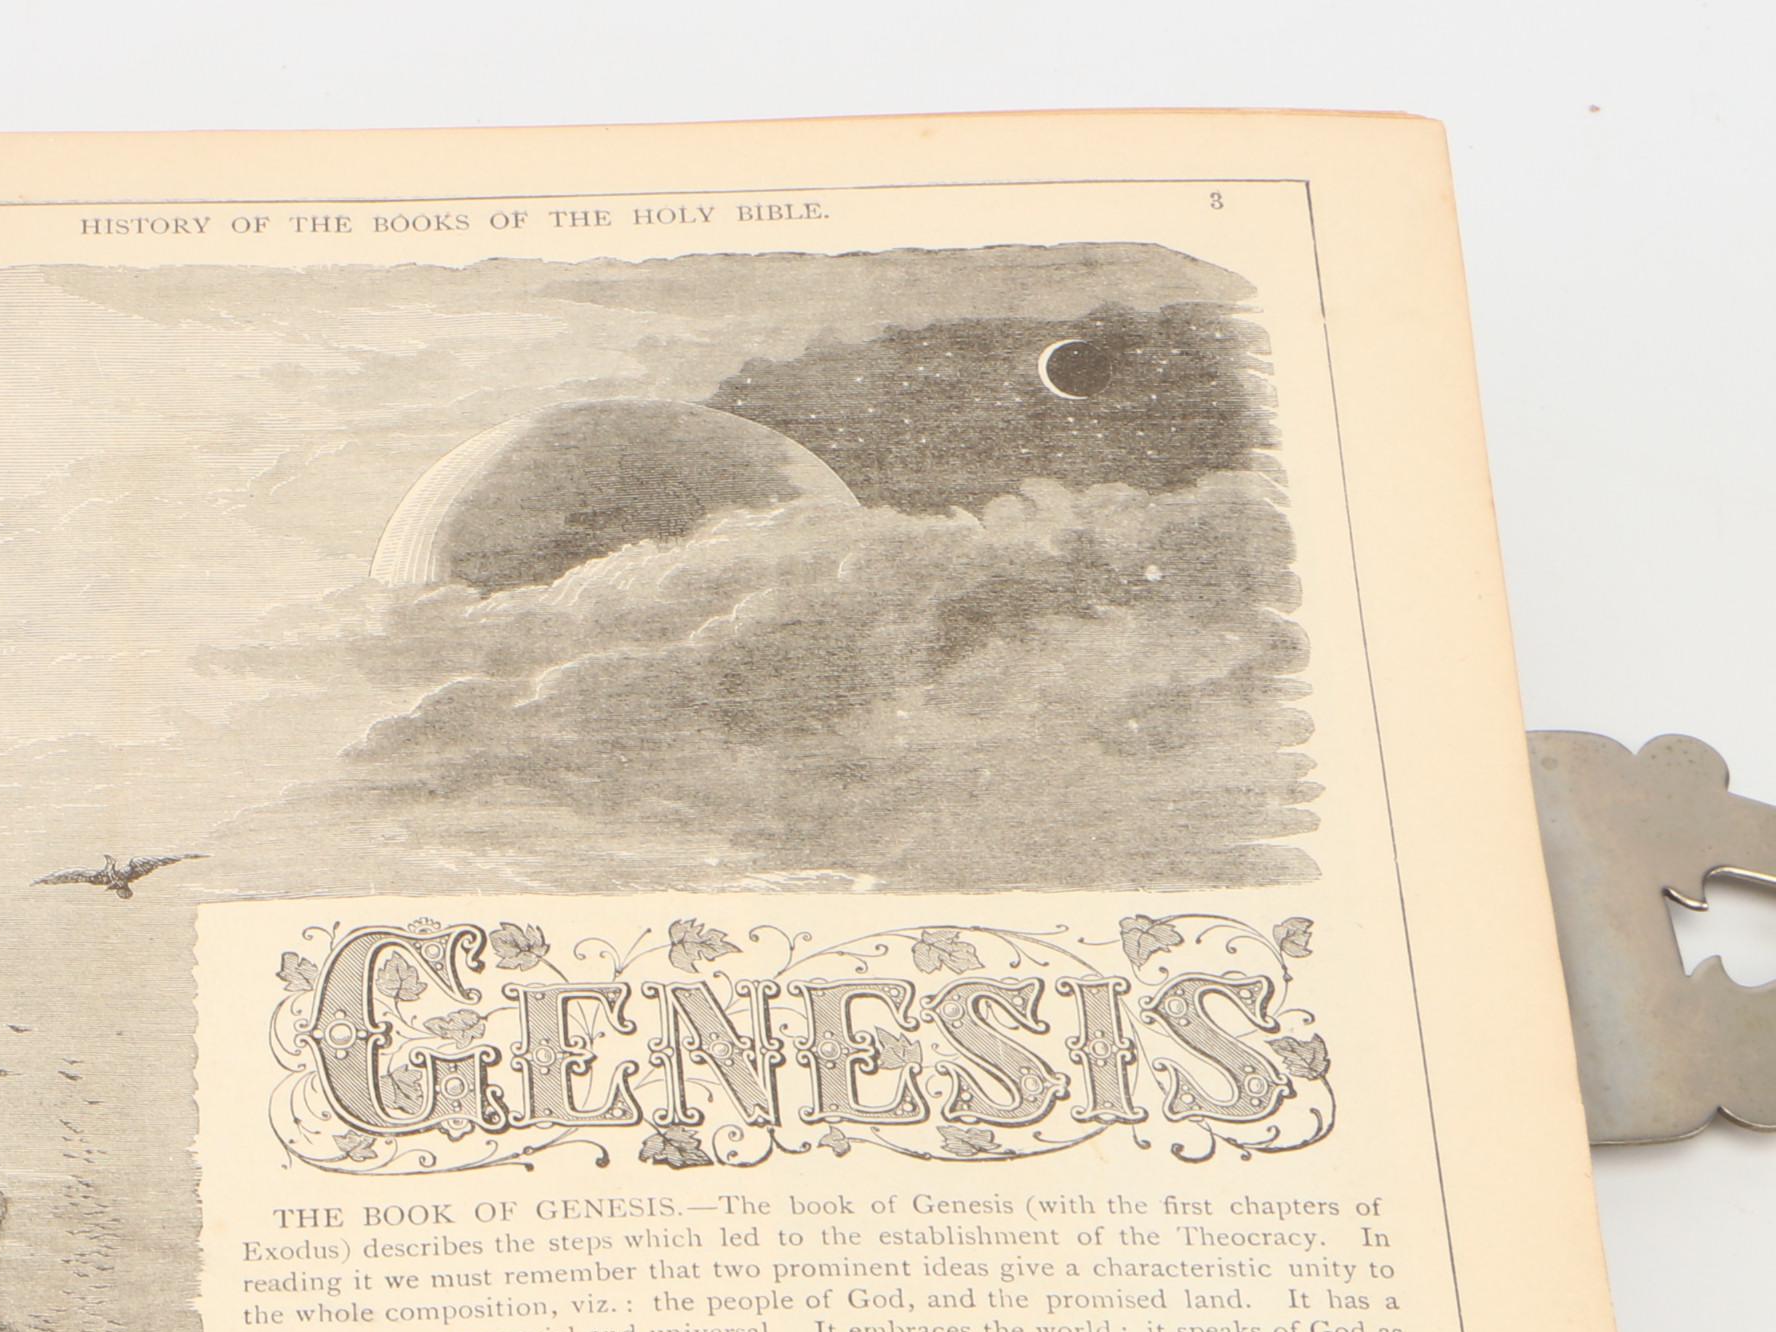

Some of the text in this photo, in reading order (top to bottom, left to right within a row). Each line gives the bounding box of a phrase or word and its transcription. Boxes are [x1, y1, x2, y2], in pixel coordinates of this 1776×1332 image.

[1209, 191, 1225, 210] 3
[81, 202, 830, 235] HISTORY OF THE BOOKS OF THE HOLY BIBLE.
[302, 918, 1296, 1136] GENESIS
[272, 1207, 344, 1229] THE
[363, 1203, 455, 1227] BOOK
[474, 1201, 518, 1223] OF
[789, 1194, 855, 1215] book
[870, 1194, 898, 1215] of
[912, 1193, 1014, 1215] Genesis
[1025, 1194, 1096, 1221] (with
[1107, 1194, 1148, 1215] the
[1163, 1194, 1213, 1216] first
[1229, 1194, 1340, 1222] chapters
[1355, 1196, 1383, 1217] of
